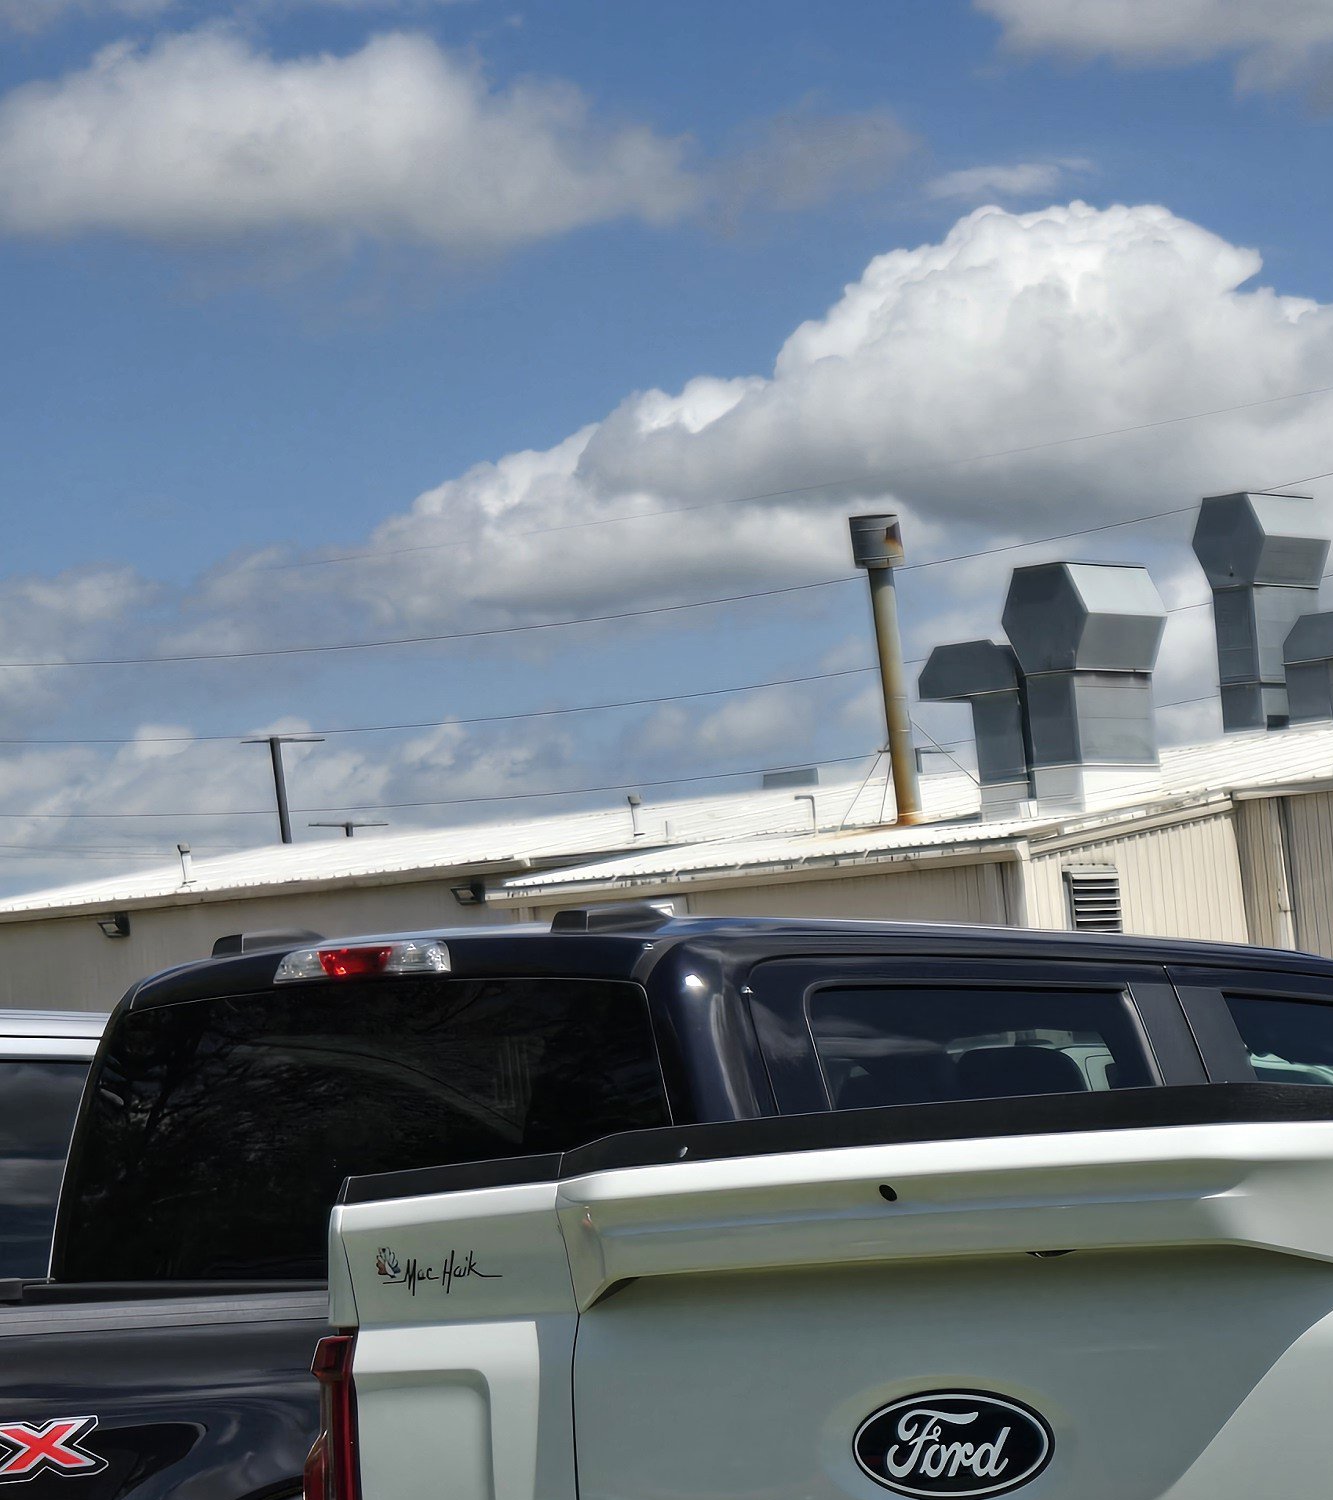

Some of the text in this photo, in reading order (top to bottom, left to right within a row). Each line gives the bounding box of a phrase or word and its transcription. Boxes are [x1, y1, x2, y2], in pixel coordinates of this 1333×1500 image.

[383, 1250, 503, 1296] Mac Haik
[886, 1409, 1011, 1478] Ford
